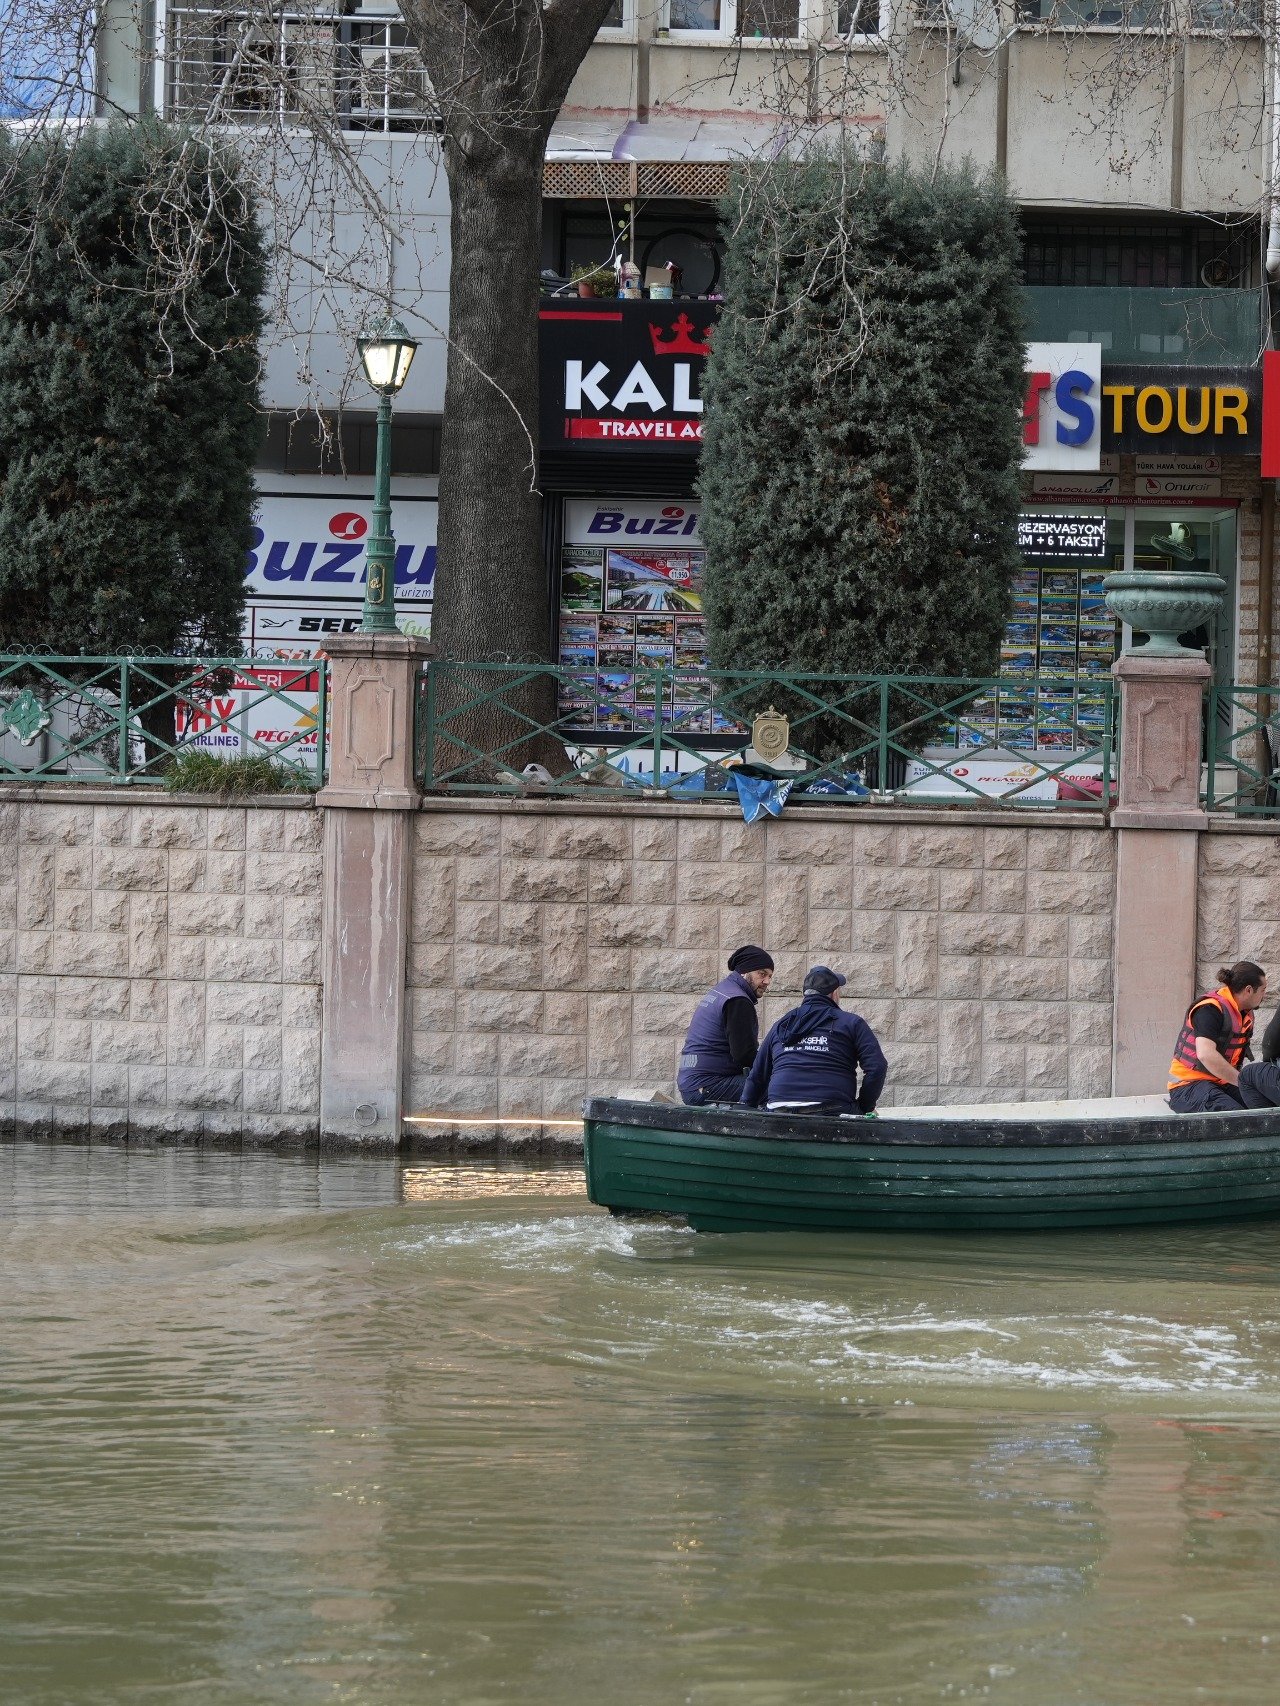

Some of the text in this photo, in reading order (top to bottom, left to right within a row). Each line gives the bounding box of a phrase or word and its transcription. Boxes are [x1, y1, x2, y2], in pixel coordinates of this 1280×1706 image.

[1022, 370, 1096, 448] TS
[1102, 385, 1250, 435] TOUR
[598, 421, 676, 438] TRAVEL
[1164, 481, 1213, 492] Onurair
[1047, 535, 1055, 546] 6
[1057, 534, 1101, 547] TAKSİT
